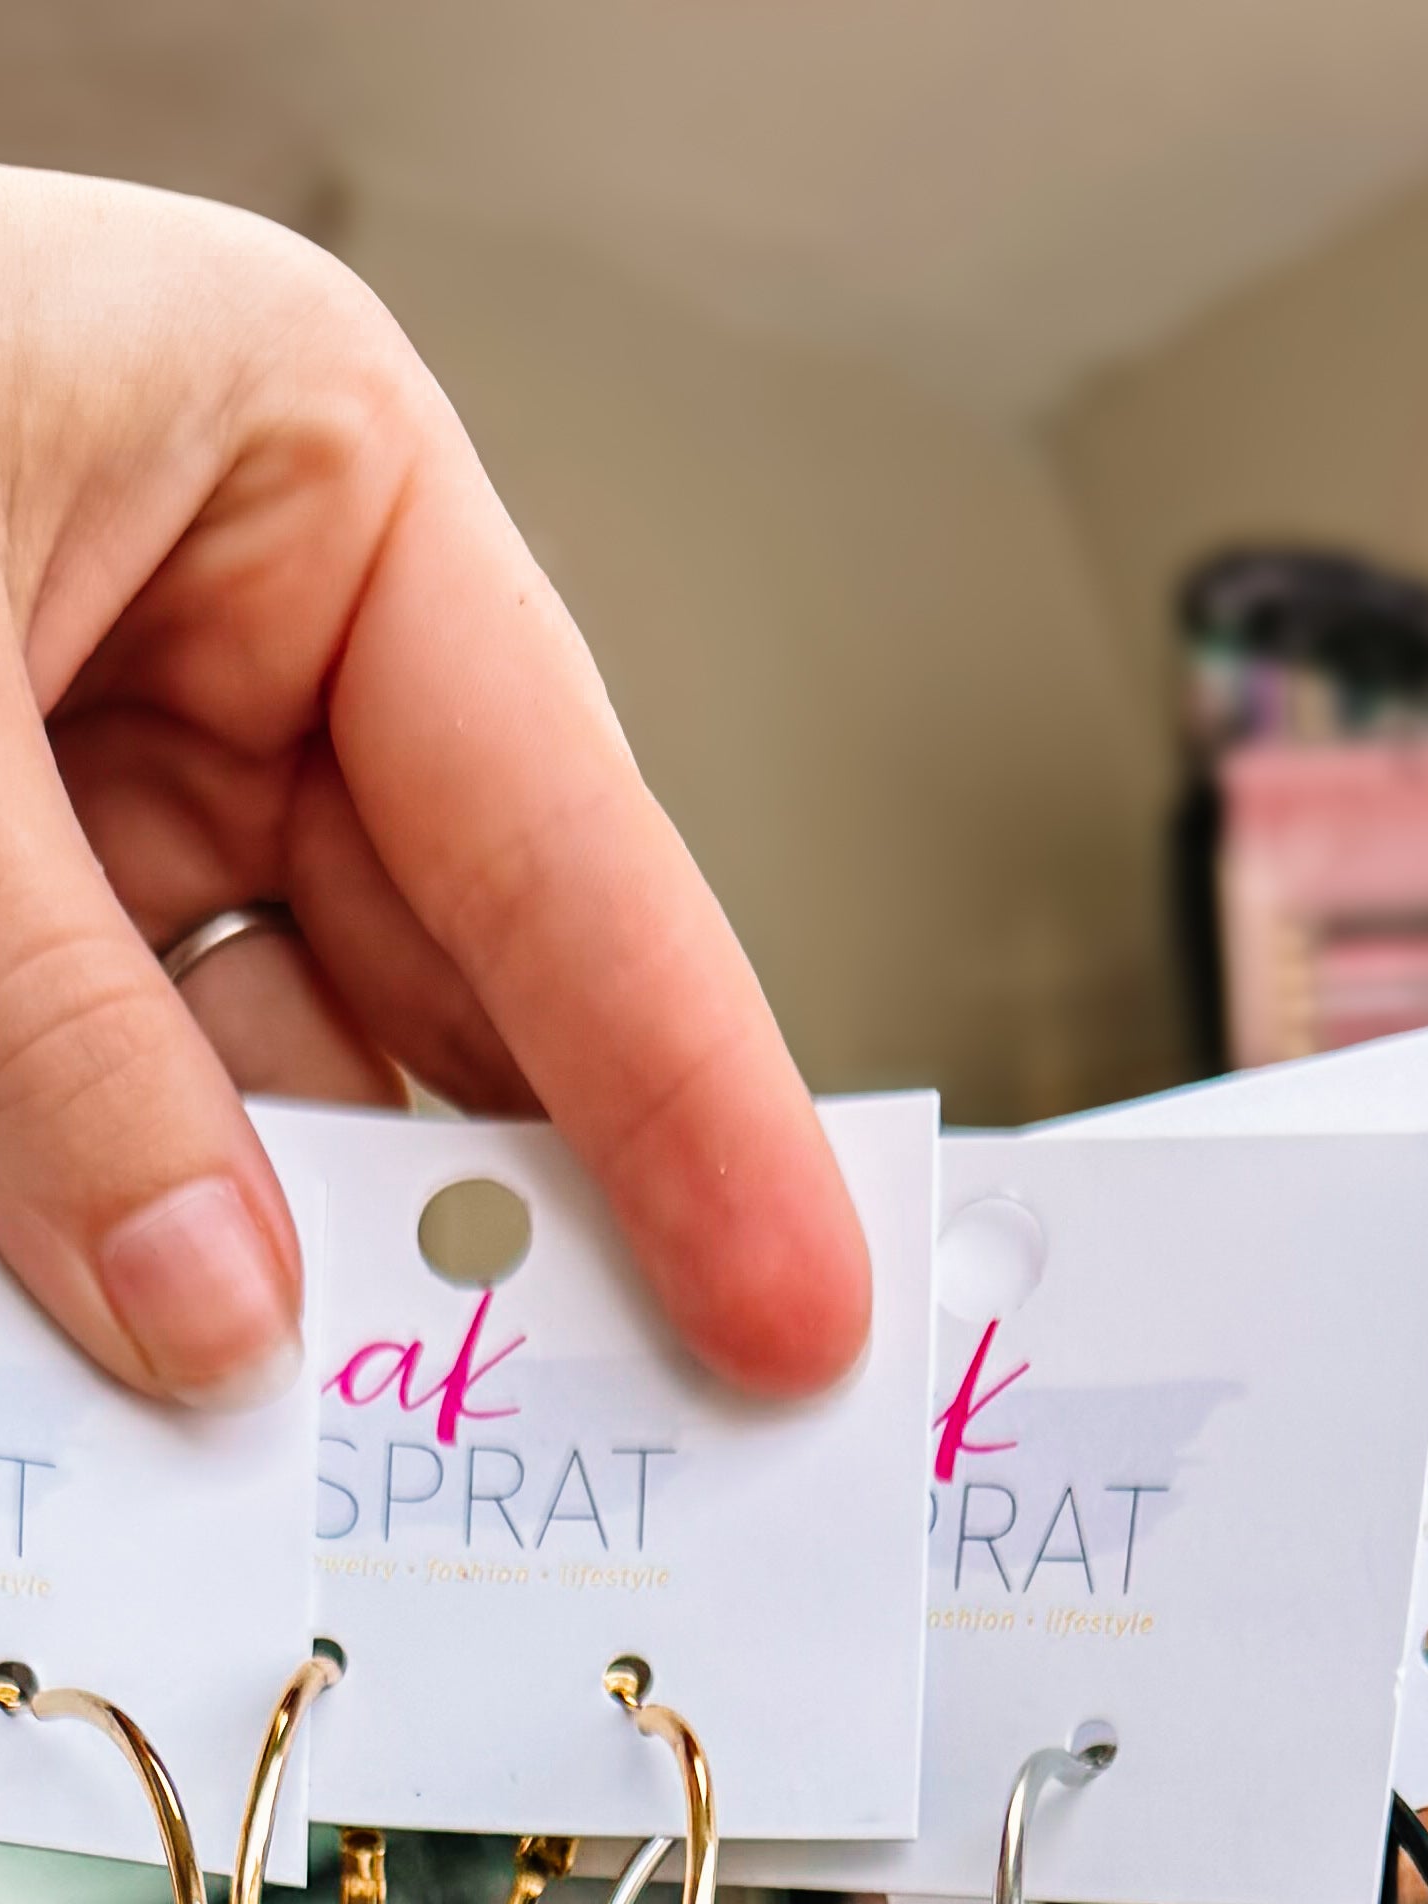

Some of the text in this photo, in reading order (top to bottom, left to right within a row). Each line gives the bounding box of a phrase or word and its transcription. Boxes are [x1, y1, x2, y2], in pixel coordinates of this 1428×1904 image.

[320, 1287, 526, 1445] ak
[313, 1556, 671, 1590] welry fashion lifestyle
[929, 1483, 1170, 1595] RAT
[927, 1606, 1155, 1640] ashion lifestyle
